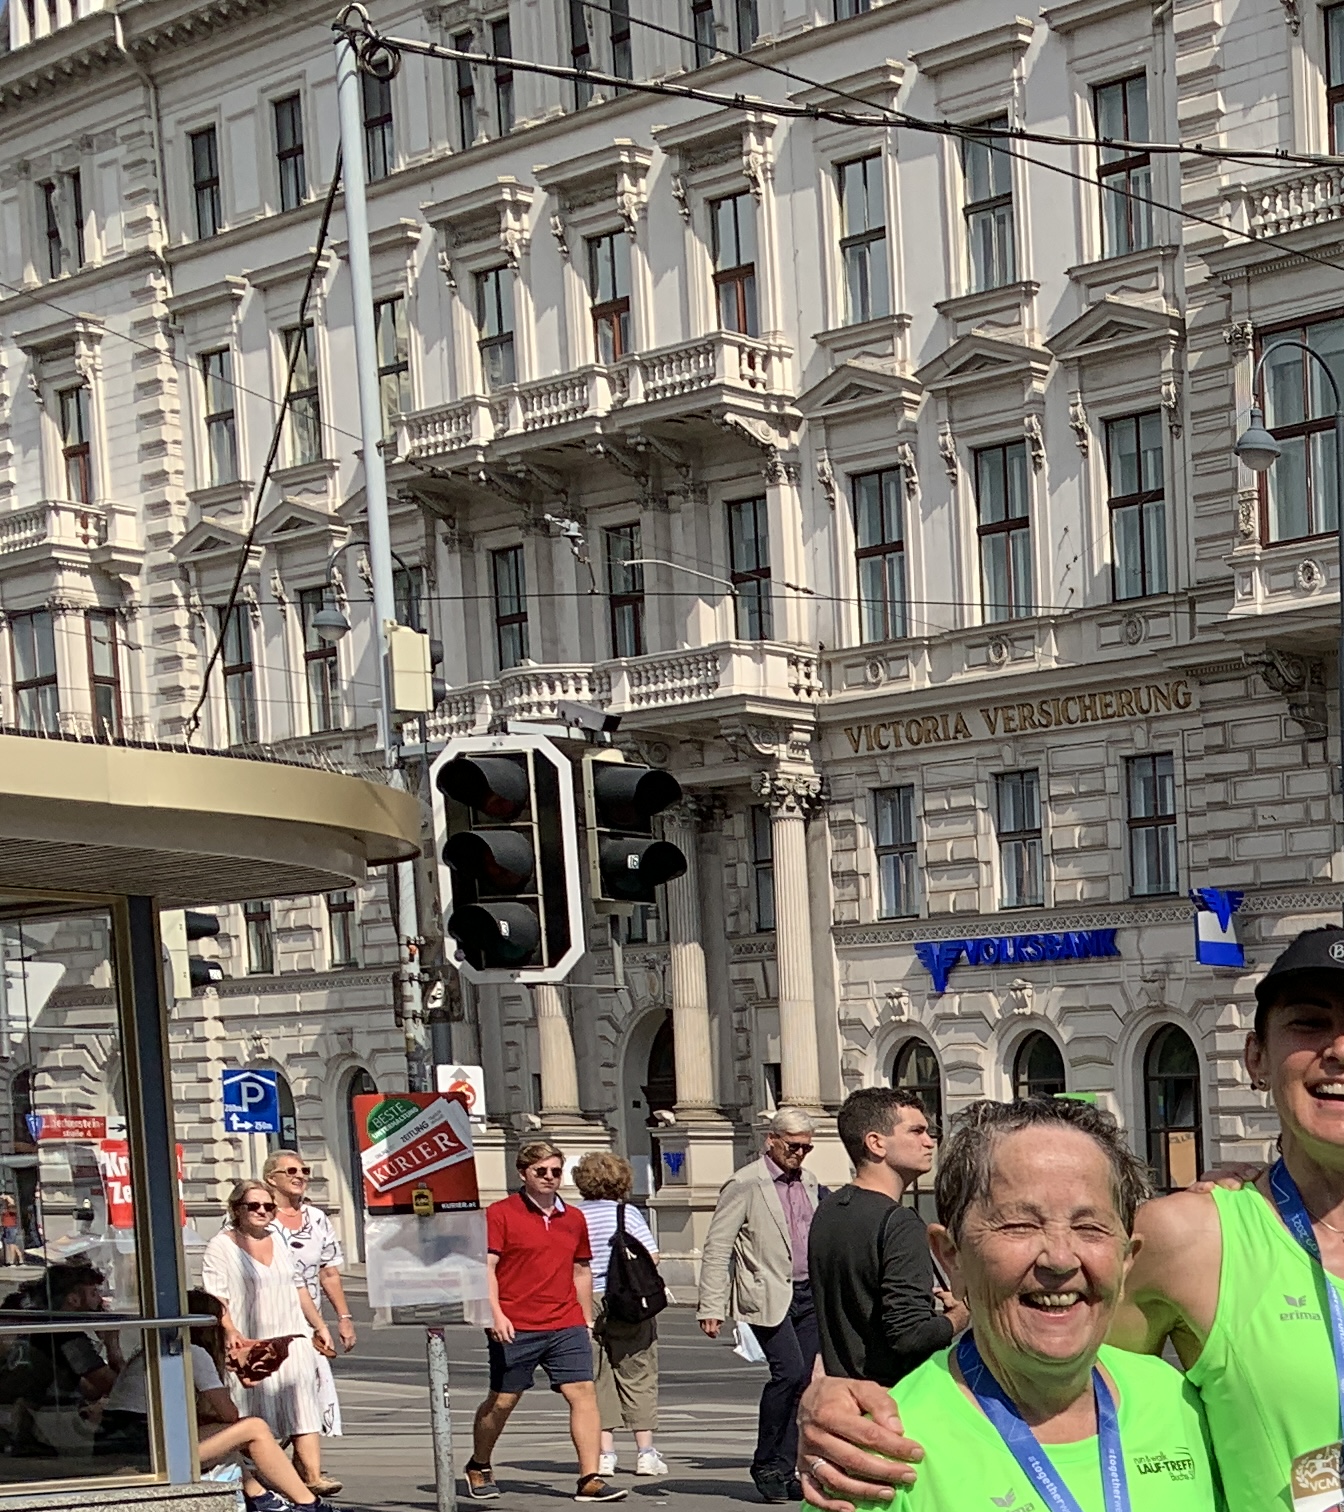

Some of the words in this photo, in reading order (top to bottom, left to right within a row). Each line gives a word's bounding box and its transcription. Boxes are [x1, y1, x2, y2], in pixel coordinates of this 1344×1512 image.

[844, 712, 972, 754] VICTORIA
[980, 680, 1193, 736] VERSICHERUNG
[964, 929, 1121, 966] VOLKSBANK
[241, 1081, 265, 1112] P
[372, 1102, 407, 1129] BESTE
[400, 1121, 429, 1143] ZEITUNG
[373, 1132, 458, 1183] KURIER
[1280, 1309, 1322, 1321] erima
[1137, 1457, 1193, 1475] LAUF-TREFF
[1309, 1478, 1339, 1492] VCM
